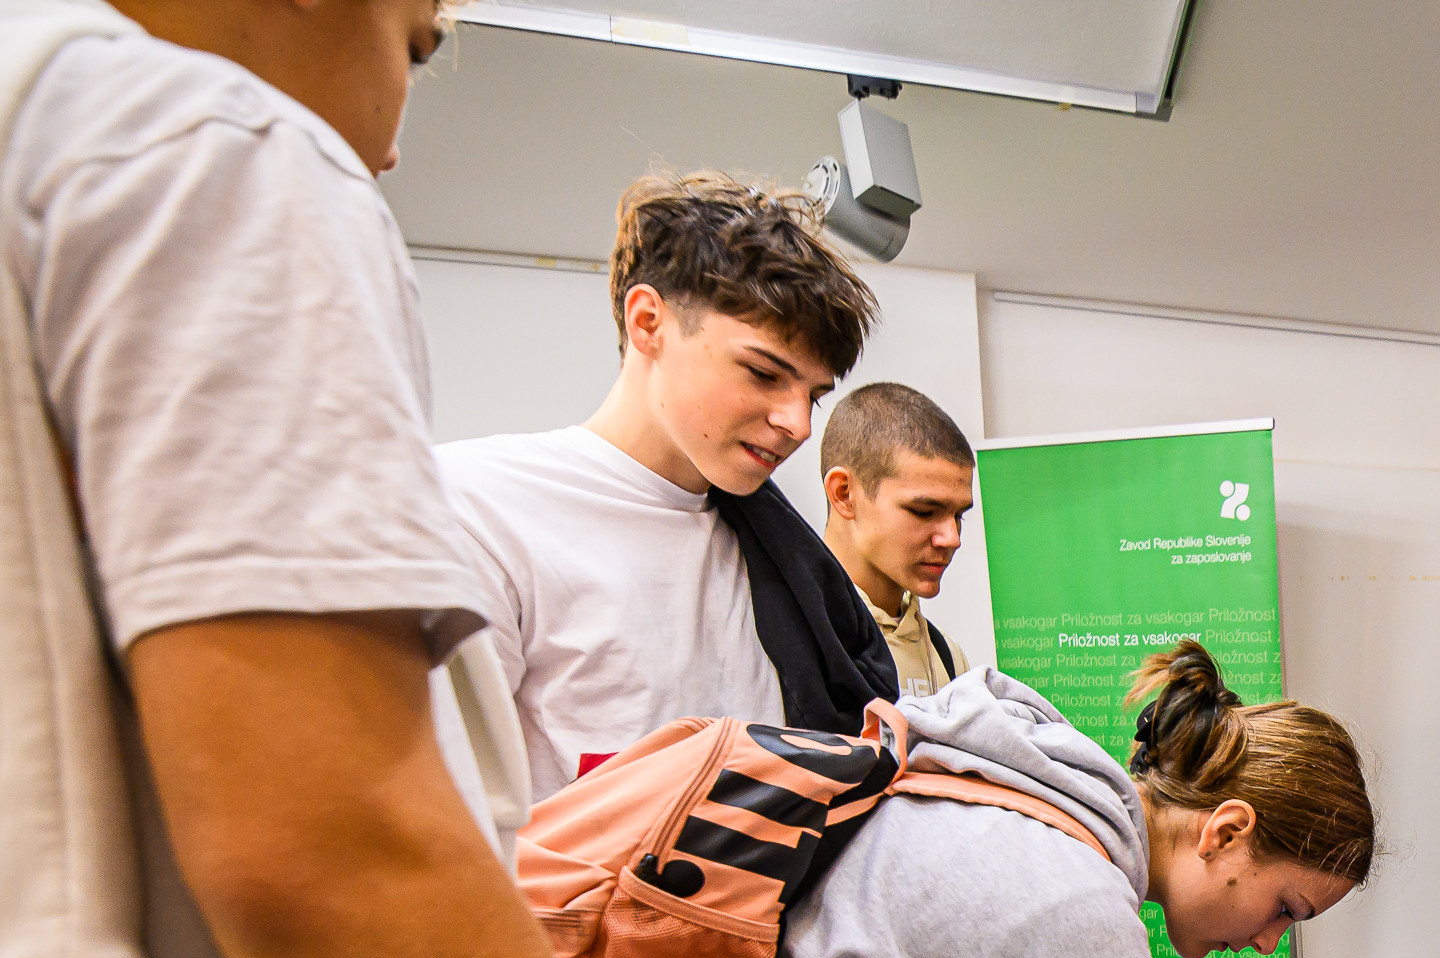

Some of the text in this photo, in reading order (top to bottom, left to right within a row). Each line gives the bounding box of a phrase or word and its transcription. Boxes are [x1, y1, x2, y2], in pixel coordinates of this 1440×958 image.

[1119, 533, 1251, 551] Zavod Republike Slovenije
[1171, 549, 1252, 565] za zaposlovanje
[1003, 615, 1058, 631] vsakogar
[1061, 612, 1123, 627] Priložnost
[1127, 614, 1142, 625] za
[1145, 610, 1205, 627] vsakogar
[1209, 607, 1276, 623] Priložnost
[1001, 635, 1055, 651] vsakogar
[1058, 632, 1120, 648] Priložnost
[1124, 634, 1139, 646] za
[1205, 628, 1272, 643] Priložnost
[1056, 653, 1118, 667] Priložnost
[1121, 655, 1136, 666] za
[1053, 673, 1114, 688] Priložnost
[1051, 693, 1111, 707] Priložnost
[1112, 716, 1127, 727] za
[1110, 736, 1124, 746] za
